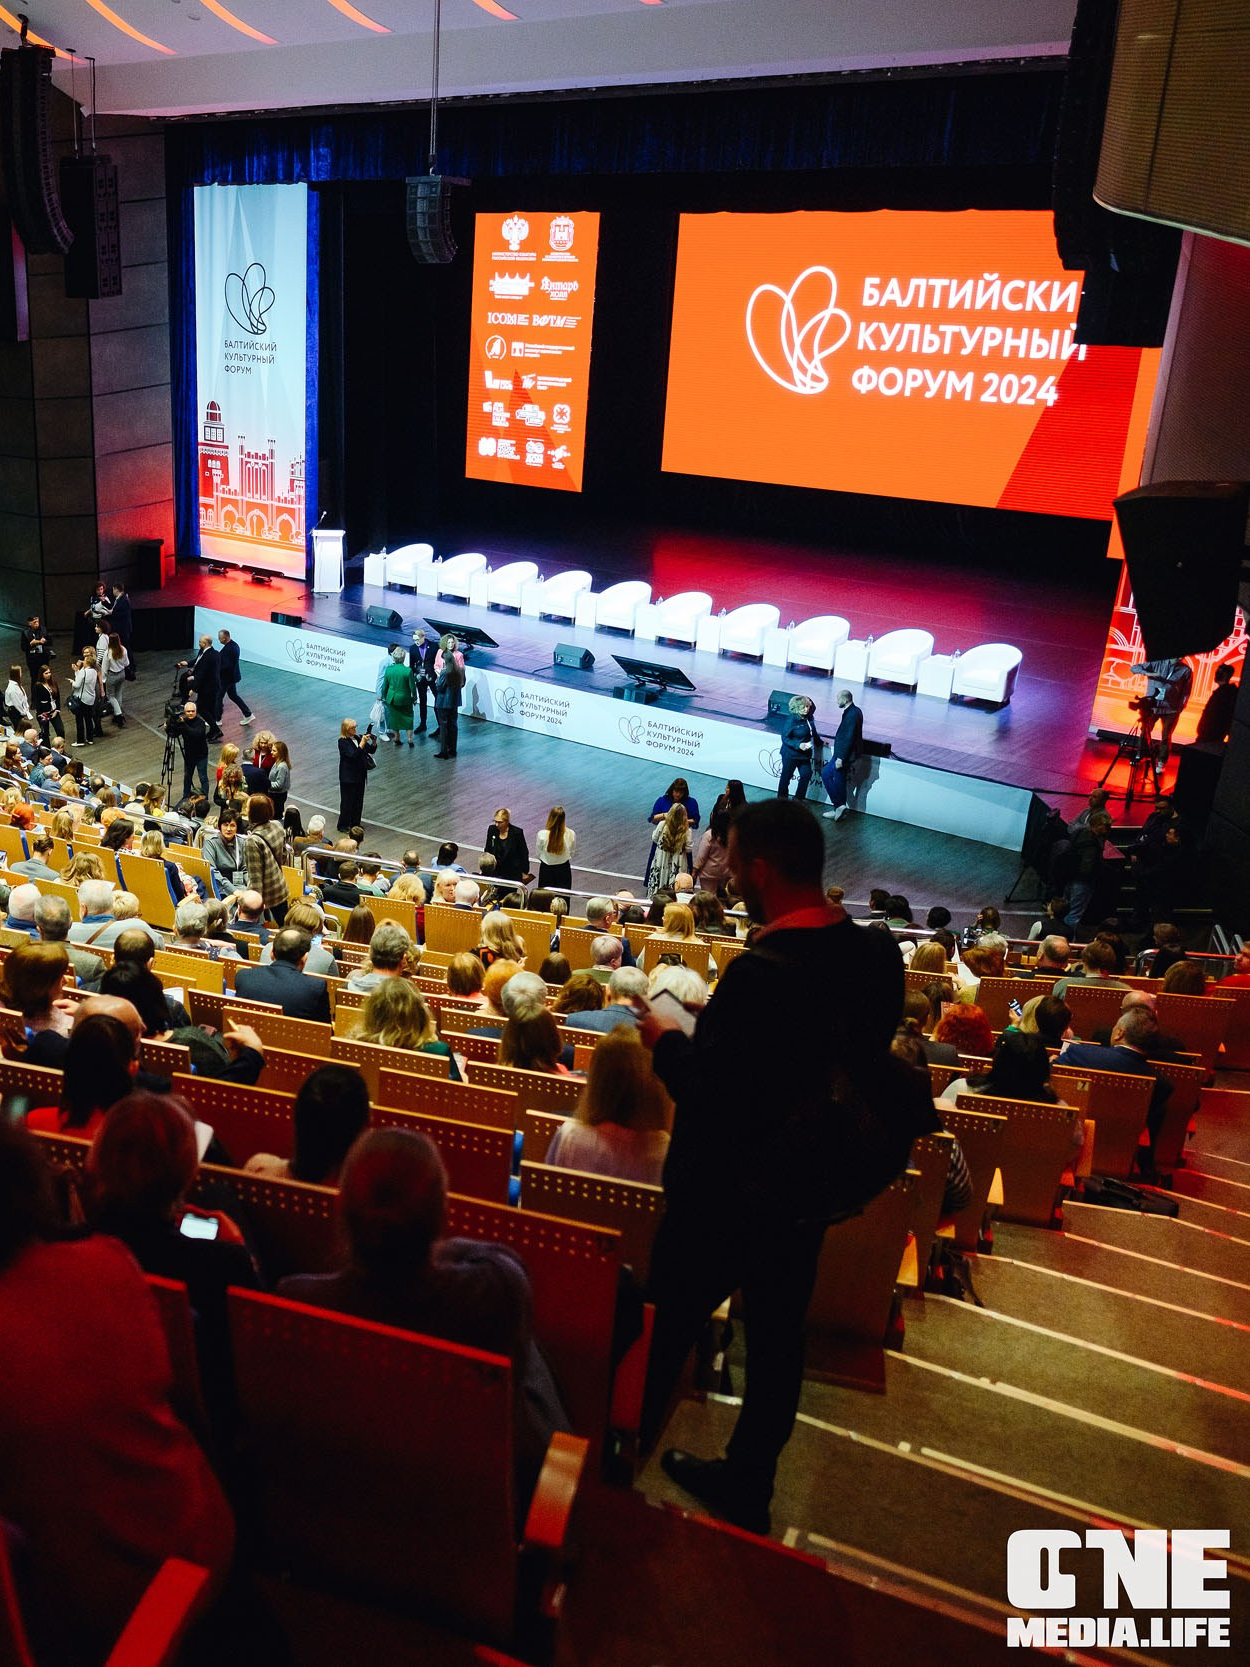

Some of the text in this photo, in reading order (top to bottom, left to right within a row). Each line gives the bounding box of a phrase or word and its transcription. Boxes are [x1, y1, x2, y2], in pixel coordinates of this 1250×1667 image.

[862, 273, 1078, 313] БАЛТИЙСКИ
[225, 340, 277, 351] БАЛТИЙСКИЙ
[857, 322, 1087, 361] КУЛЬТУРНЫЙ
[224, 353, 275, 364] КУЛЬТУРНЫЙ
[224, 365, 252, 374] ФОРУМ
[851, 365, 1058, 407] ФОРУМ 2024
[306, 642, 347, 657] БАЛТИЙСКИЙ
[306, 652, 345, 665] КУЛЬТУРНЫЙ
[306, 660, 341, 672] ФОРУМ 2024
[520, 691, 570, 709] БАЛТИЙСКИЙ
[520, 701, 568, 717] КУЛЬТУРНЫЙ
[520, 710, 562, 725] ФОРУМ 2024
[647, 720, 704, 739] БАЛТИЙСКИЙ
[646, 730, 701, 748] КУЛЬТУРНЫЙ
[646, 740, 694, 756] ФОРУМ 2024
